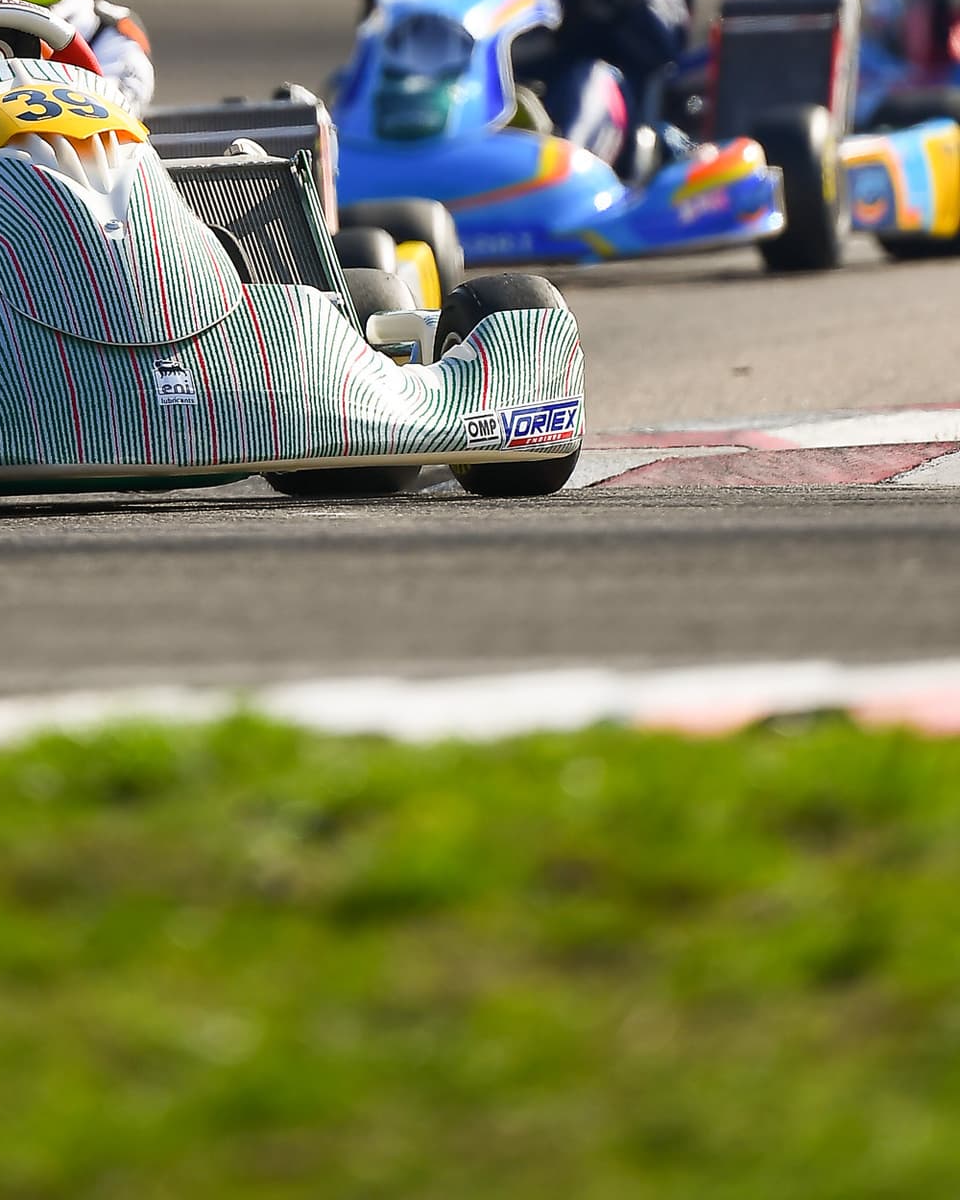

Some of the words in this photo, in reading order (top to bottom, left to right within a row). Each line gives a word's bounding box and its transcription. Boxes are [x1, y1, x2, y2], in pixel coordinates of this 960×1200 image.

[2, 88, 109, 122] 39
[161, 379, 191, 395] eni
[467, 418, 498, 437] OMP
[500, 400, 579, 445] VORTEX
